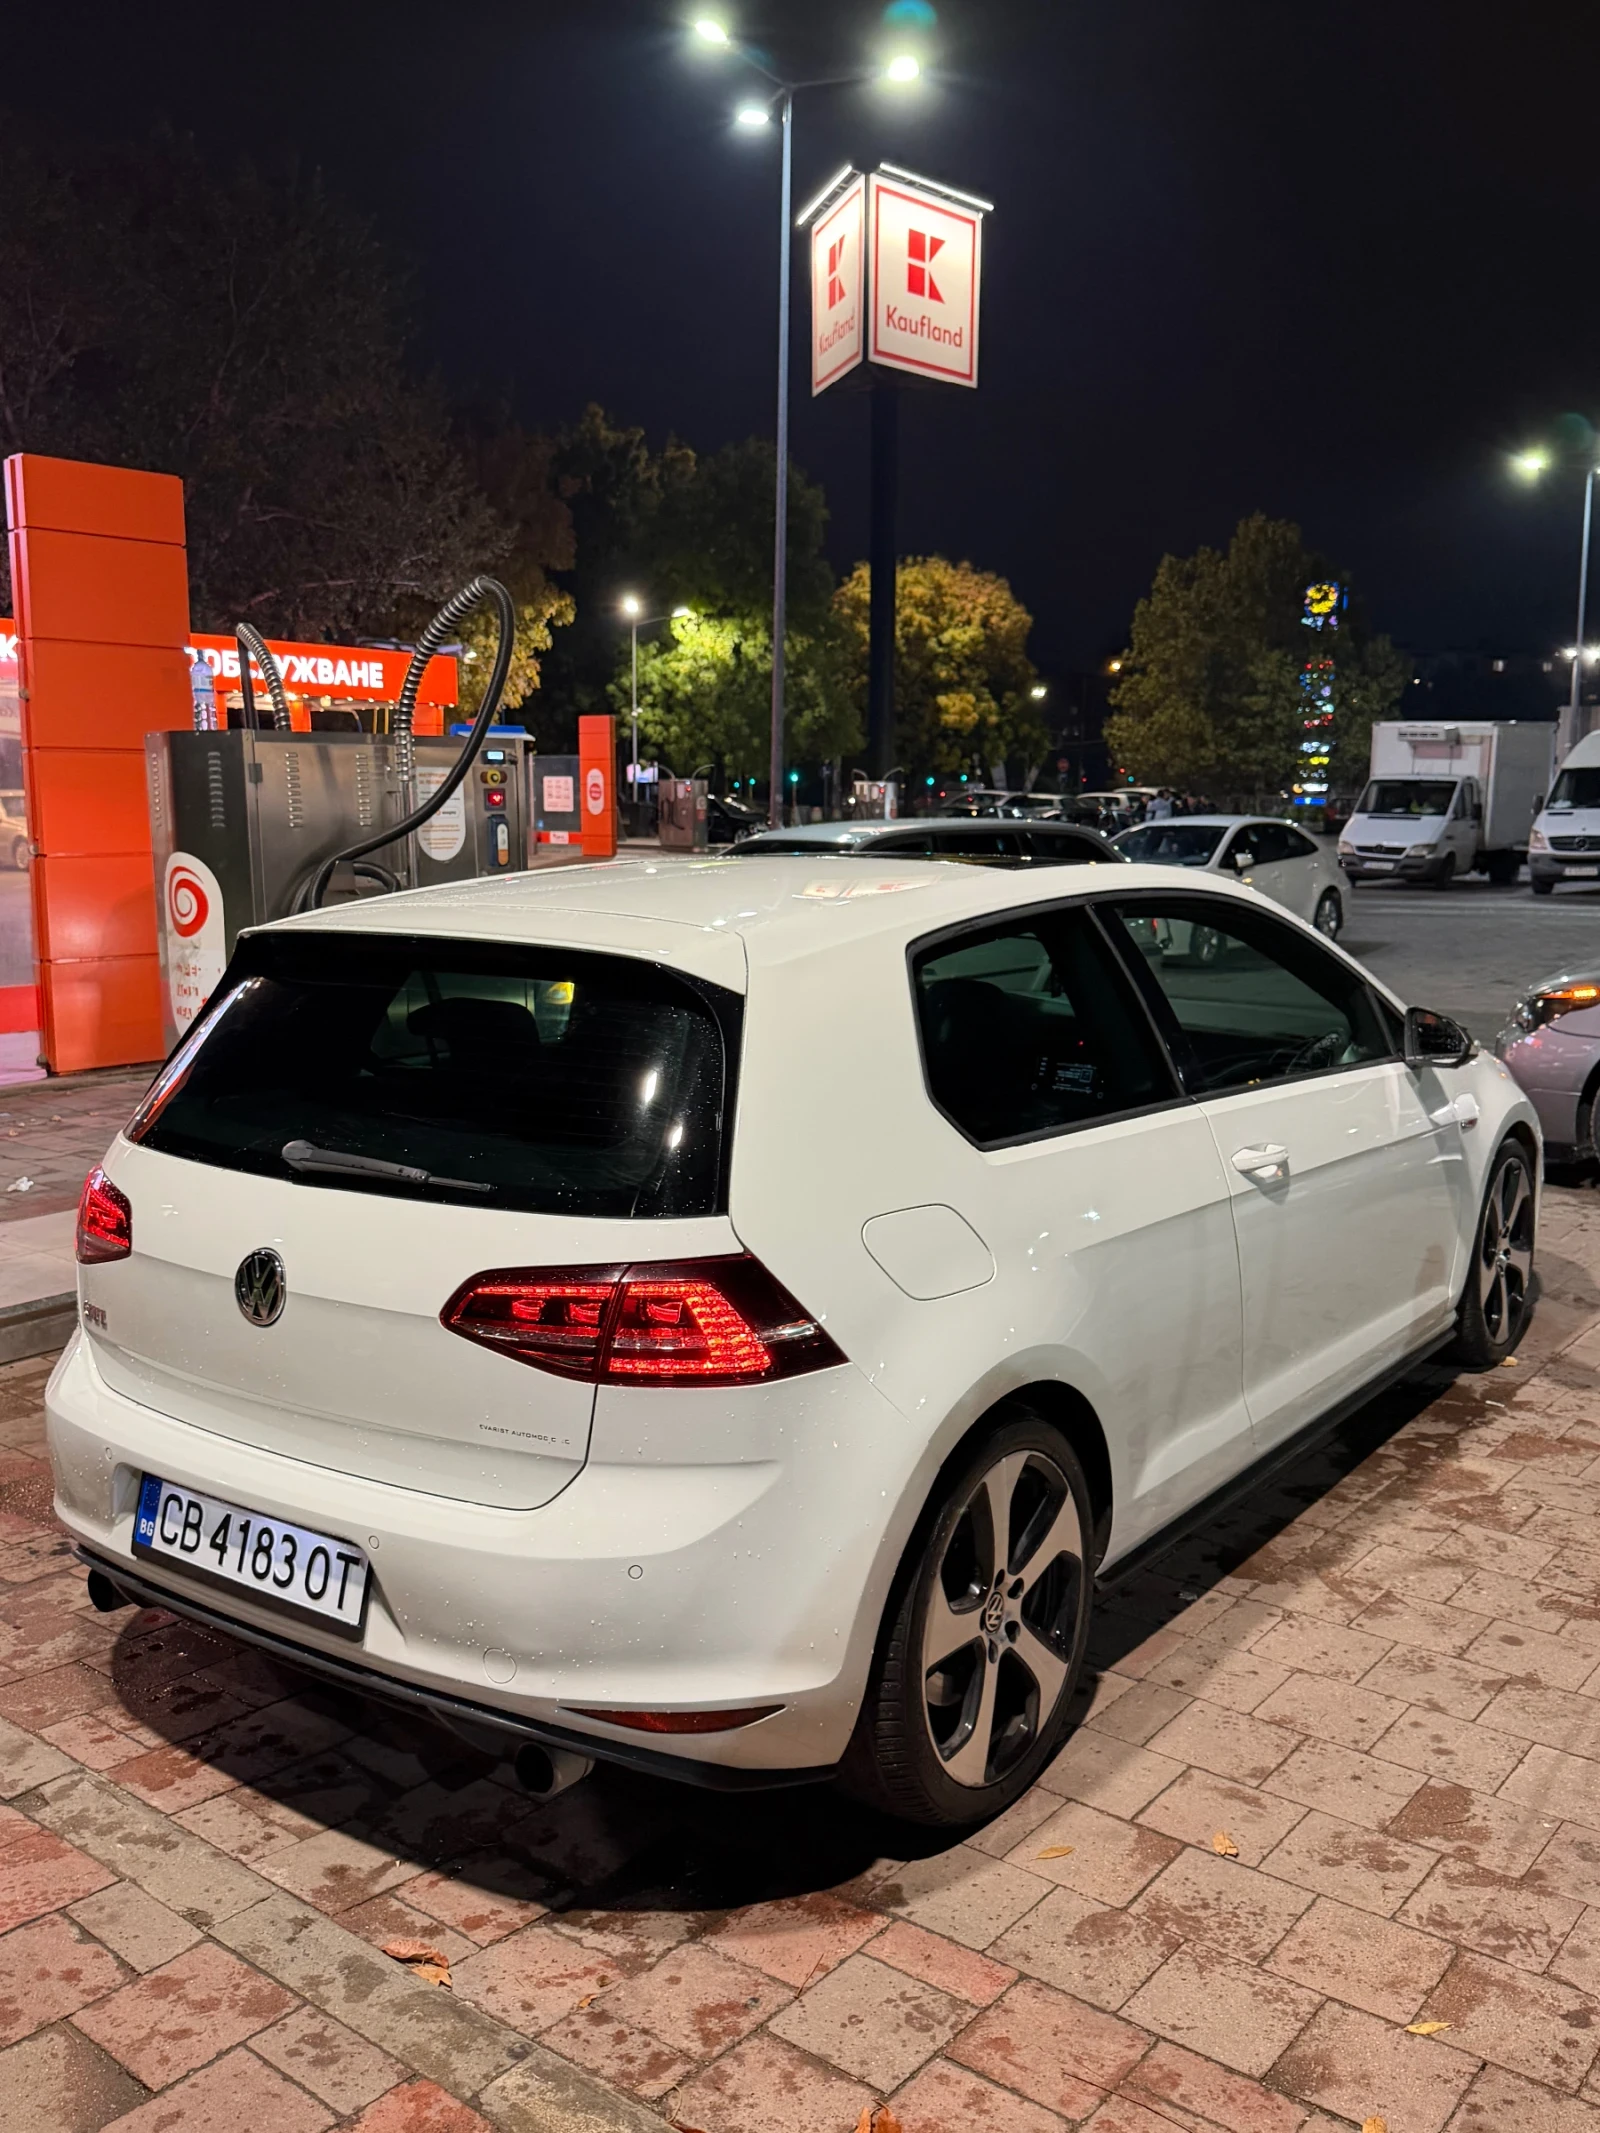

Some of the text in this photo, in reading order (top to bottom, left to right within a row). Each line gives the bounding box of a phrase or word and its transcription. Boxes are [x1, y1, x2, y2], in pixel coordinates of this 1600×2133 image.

[886, 304, 963, 348] Kaufland
[479, 1424, 509, 1434] EVARIST
[139, 1517, 155, 1537] BG
[159, 1493, 204, 1553] CB
[209, 1512, 298, 1589] 4183
